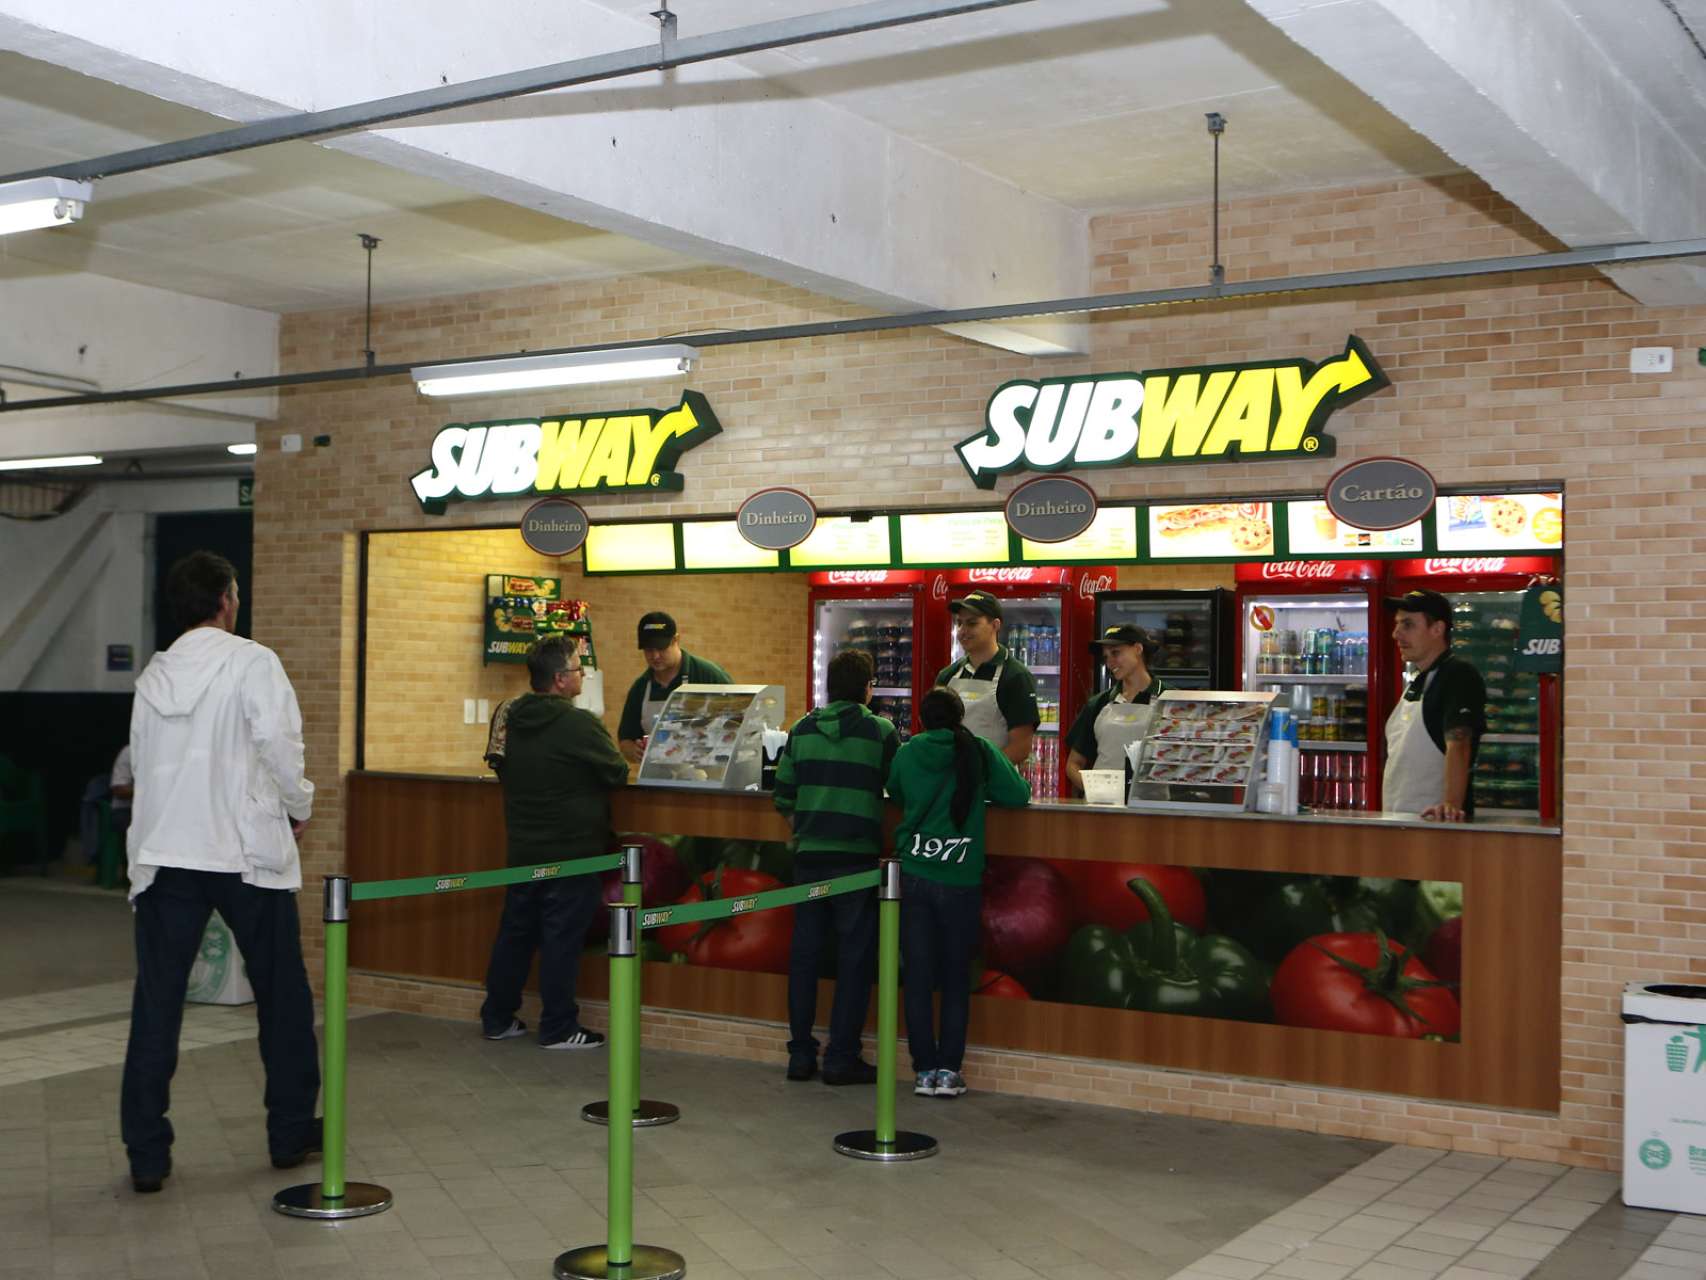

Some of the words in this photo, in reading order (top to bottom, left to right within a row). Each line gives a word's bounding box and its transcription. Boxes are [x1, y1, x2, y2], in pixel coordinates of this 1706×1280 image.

[960, 349, 1372, 476] SUBWAY
[411, 401, 698, 503] SUBWAY
[745, 512, 807, 526] Dinheiro
[1015, 500, 1087, 517] Dinheiro
[528, 520, 582, 532] Dinheiro
[911, 833, 972, 863] 1977
